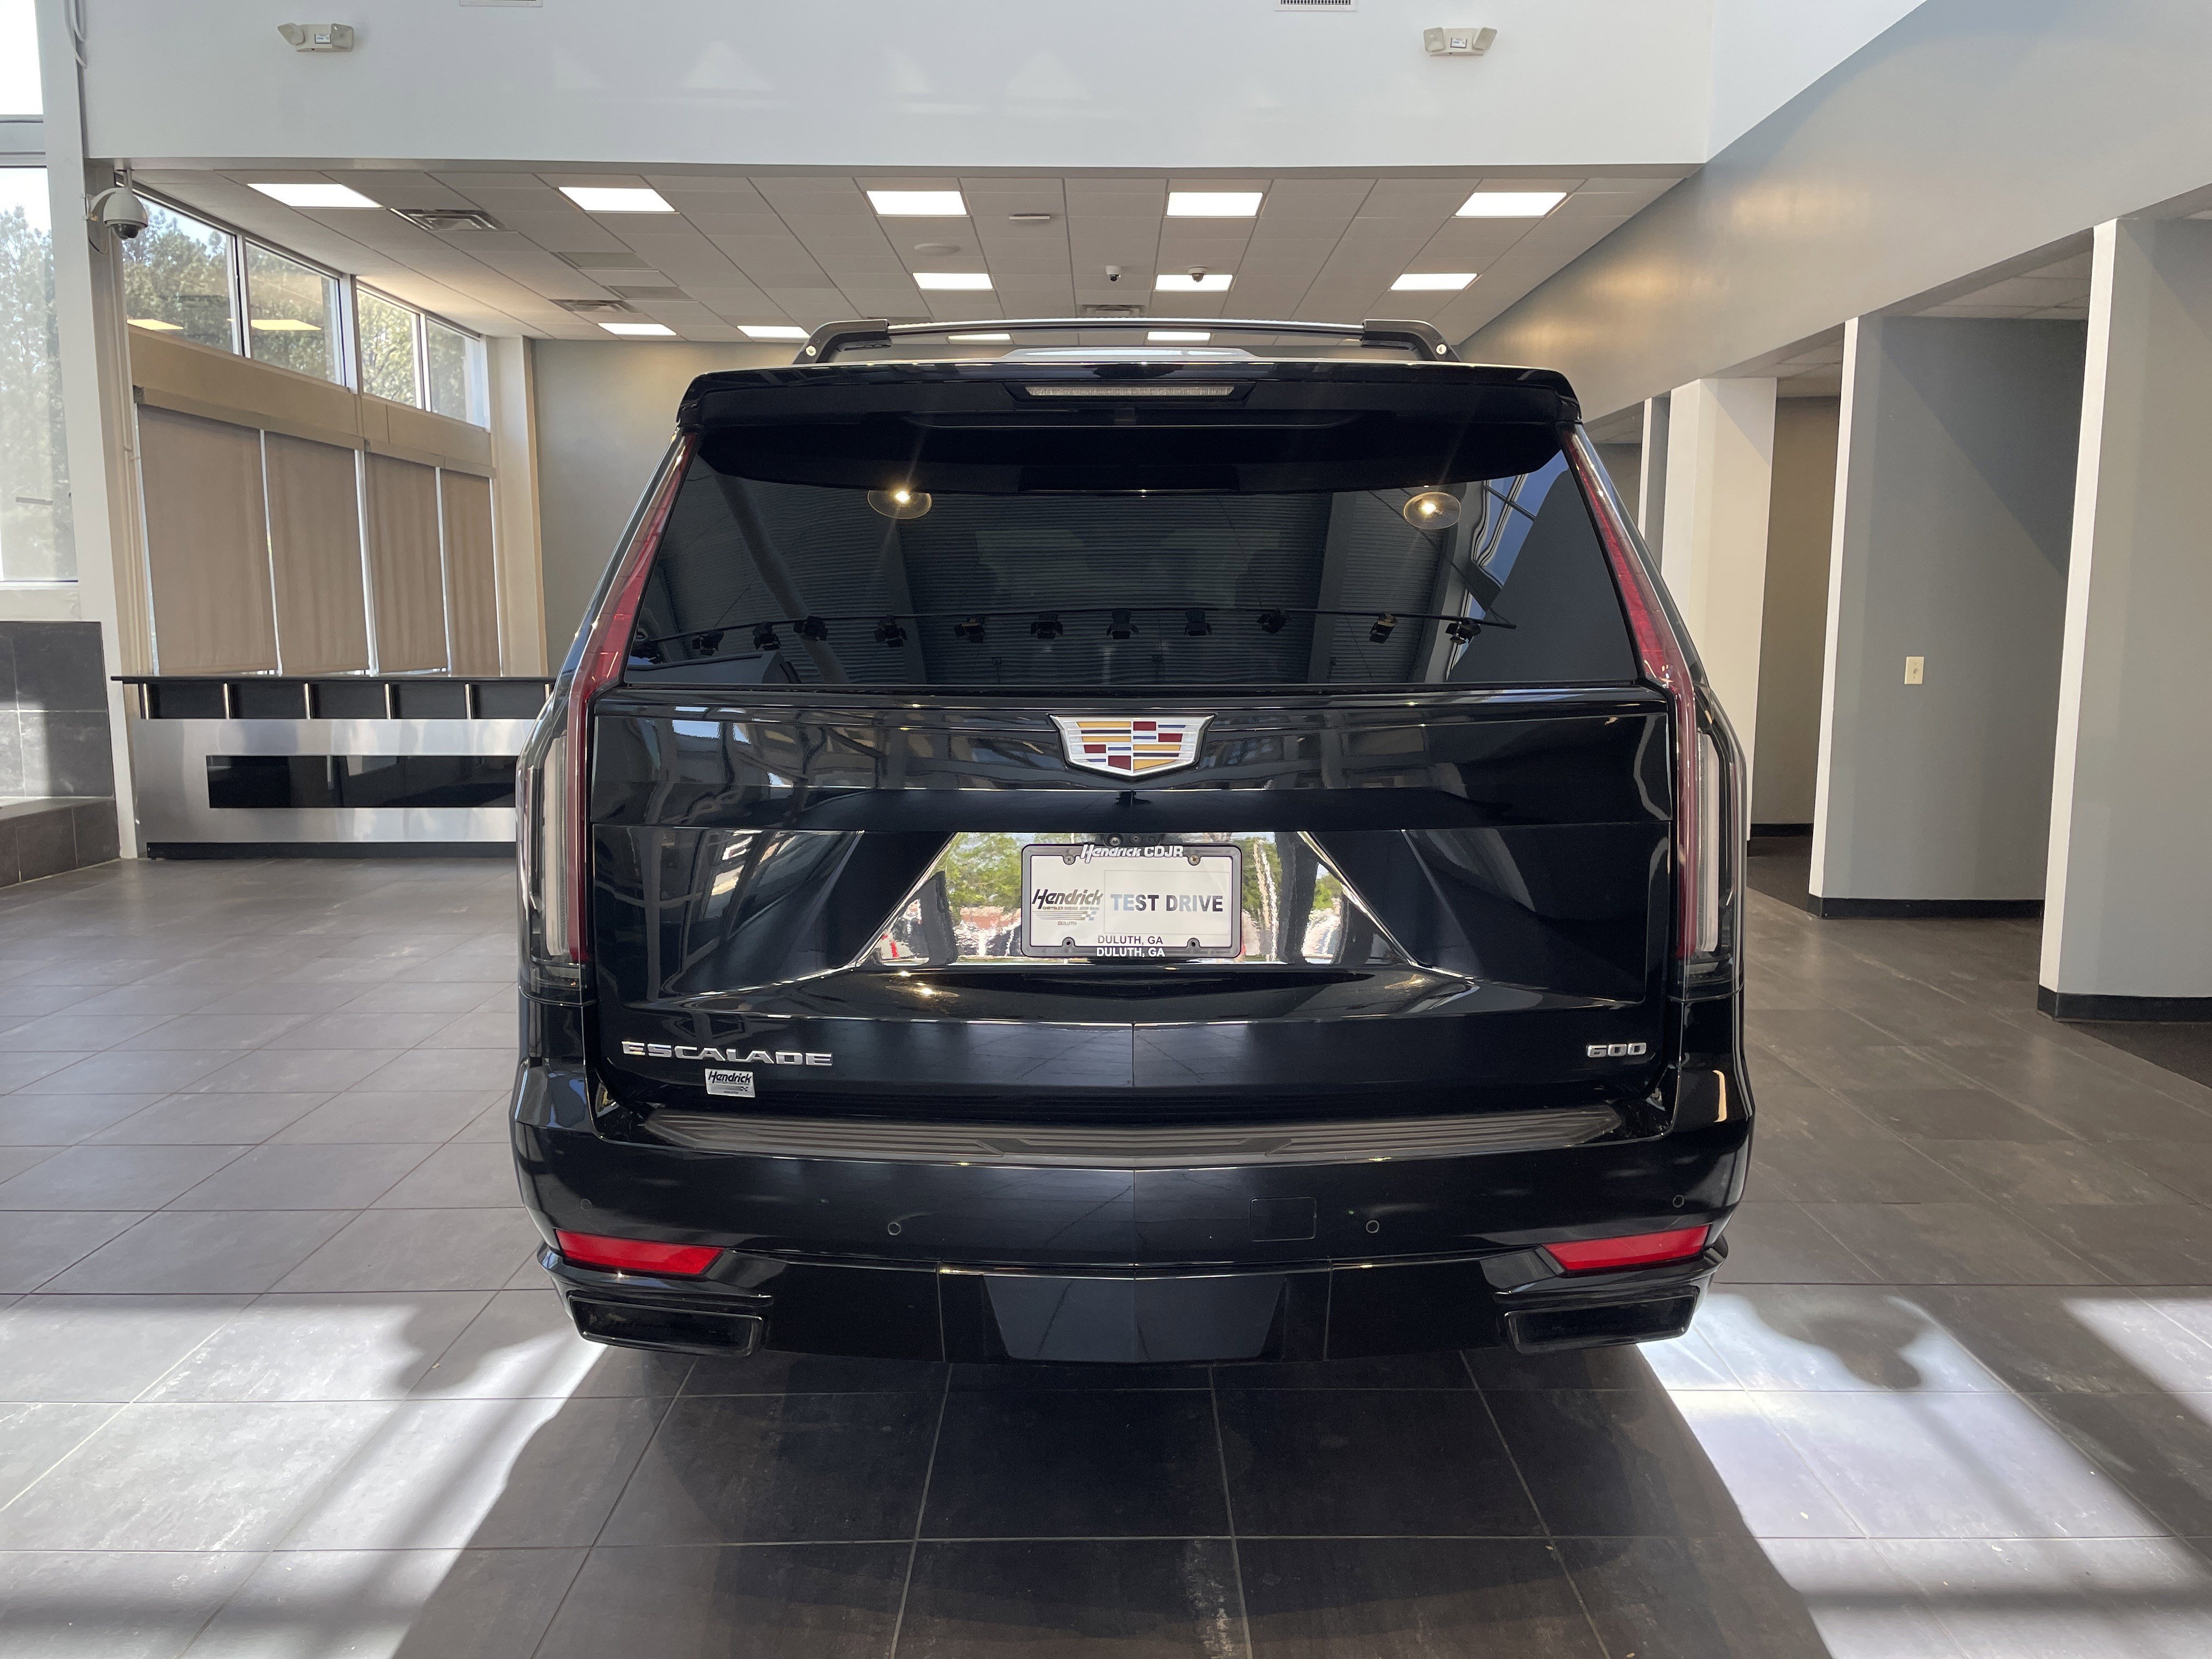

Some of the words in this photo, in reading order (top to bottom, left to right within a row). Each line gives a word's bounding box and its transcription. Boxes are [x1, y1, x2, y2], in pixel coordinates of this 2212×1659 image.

[1081, 844, 1141, 864] Hendrick
[1144, 845, 1184, 857] CDJR
[1031, 889, 1103, 909] Hendrick
[1110, 894, 1159, 911] TEST
[1166, 895, 1223, 912] DRIVE
[1098, 935, 1144, 946] DULUTH,
[1148, 936, 1164, 944] GA
[1096, 947, 1145, 957] DULUTH,
[1148, 947, 1165, 957] GA
[622, 1041, 833, 1066] ESCALADE
[1587, 1042, 1646, 1058] 600
[708, 1071, 752, 1083] Hendrick
